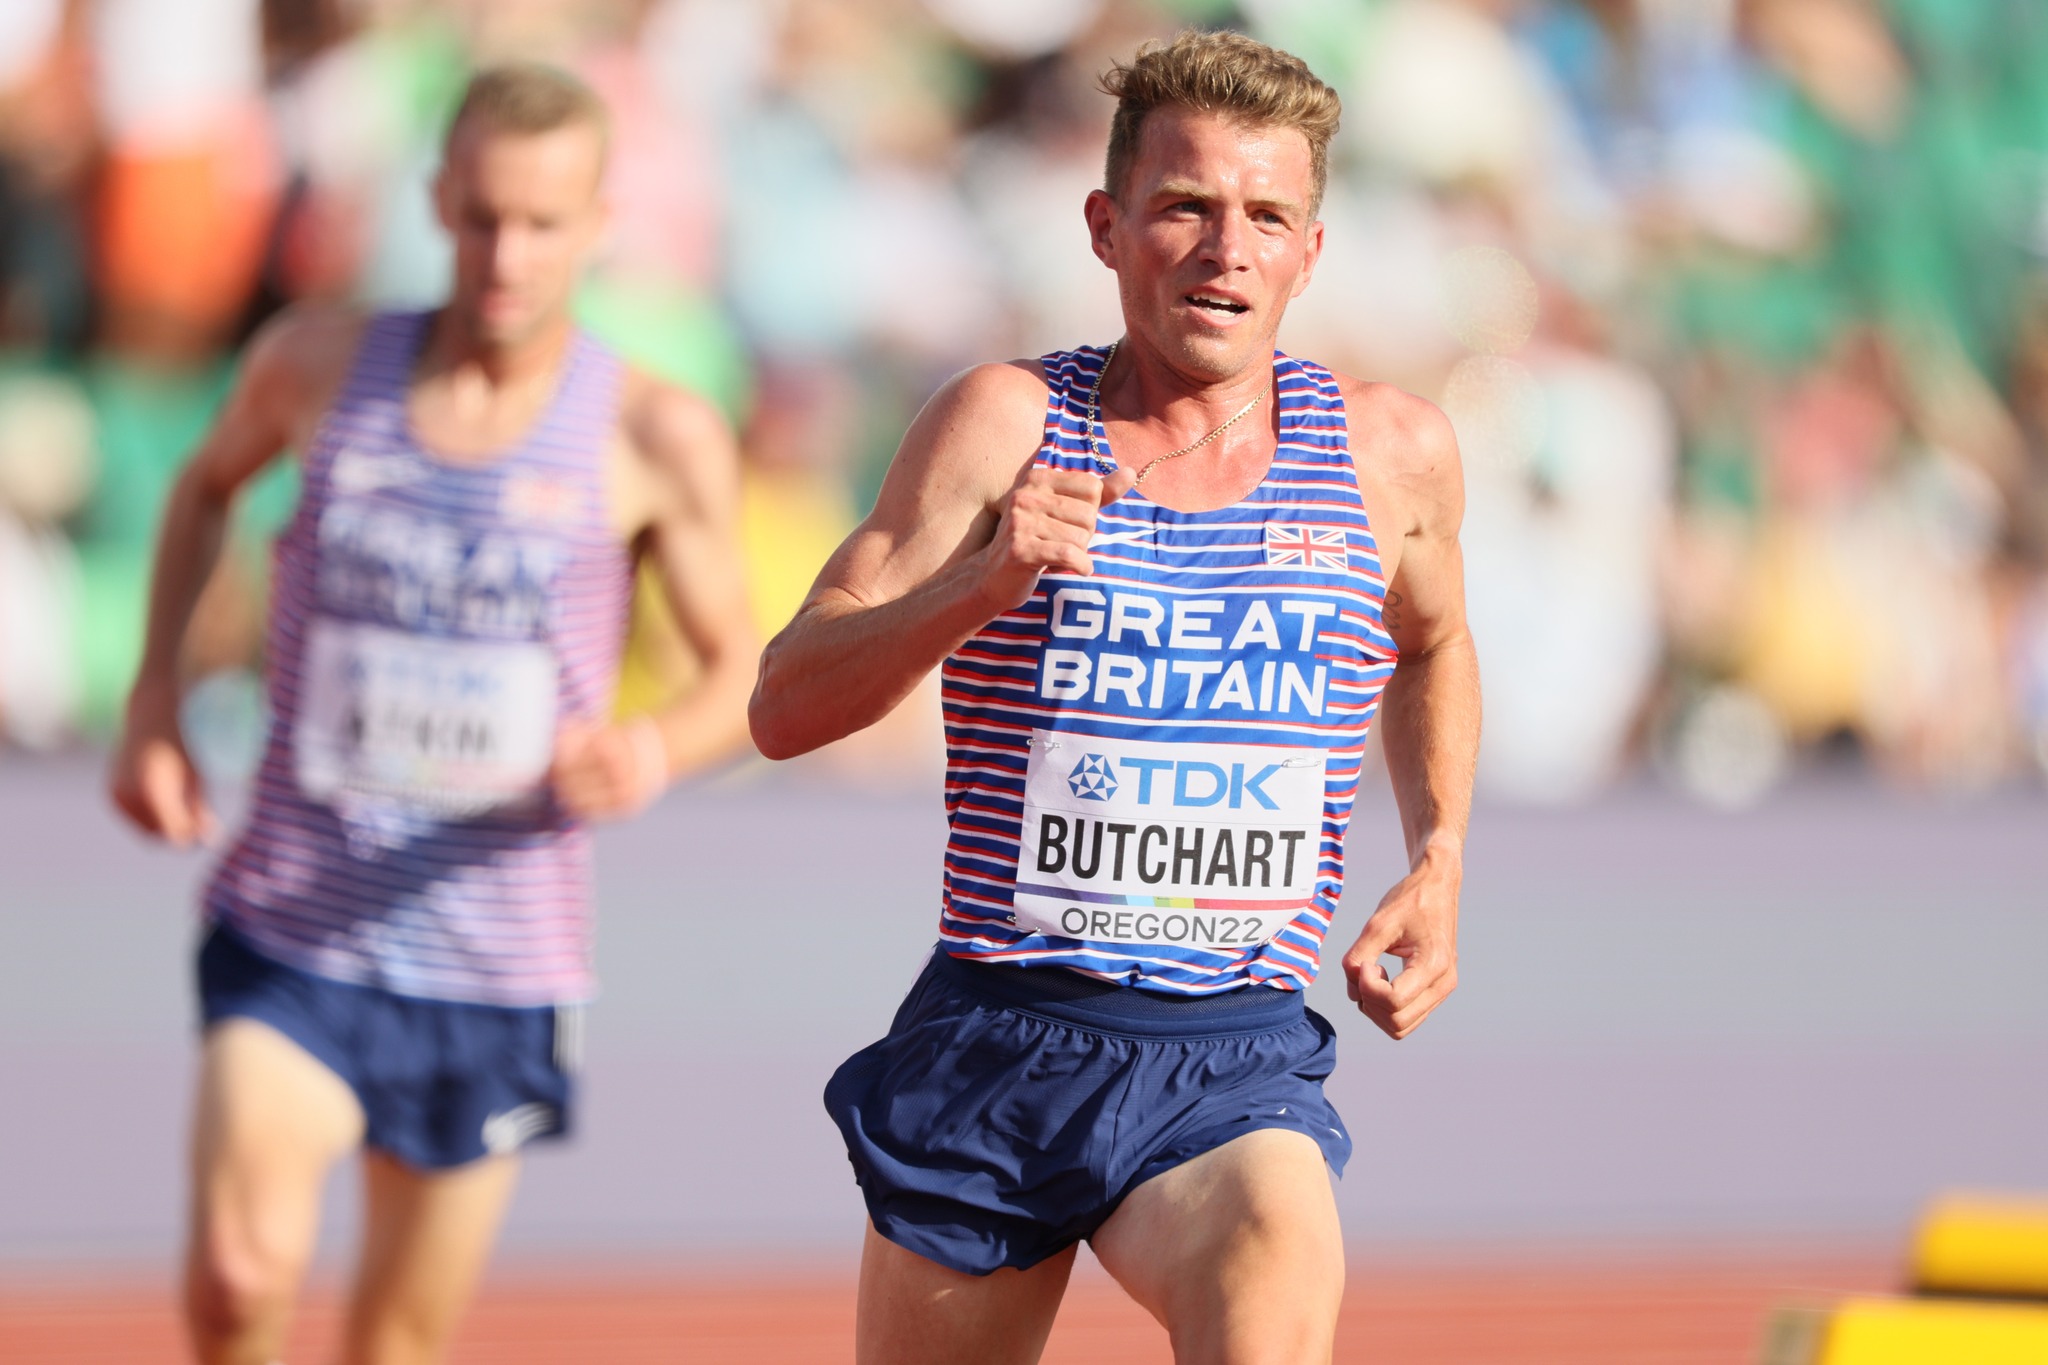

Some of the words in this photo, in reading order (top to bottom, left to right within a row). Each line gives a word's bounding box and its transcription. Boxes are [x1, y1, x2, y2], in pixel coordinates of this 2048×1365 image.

[1051, 588, 1336, 652] GREAT
[1041, 648, 1327, 717] BRITAIN
[1119, 757, 1282, 810] TDK
[1036, 814, 1305, 888] BUTCHART
[1061, 907, 1263, 943] OREGON22
